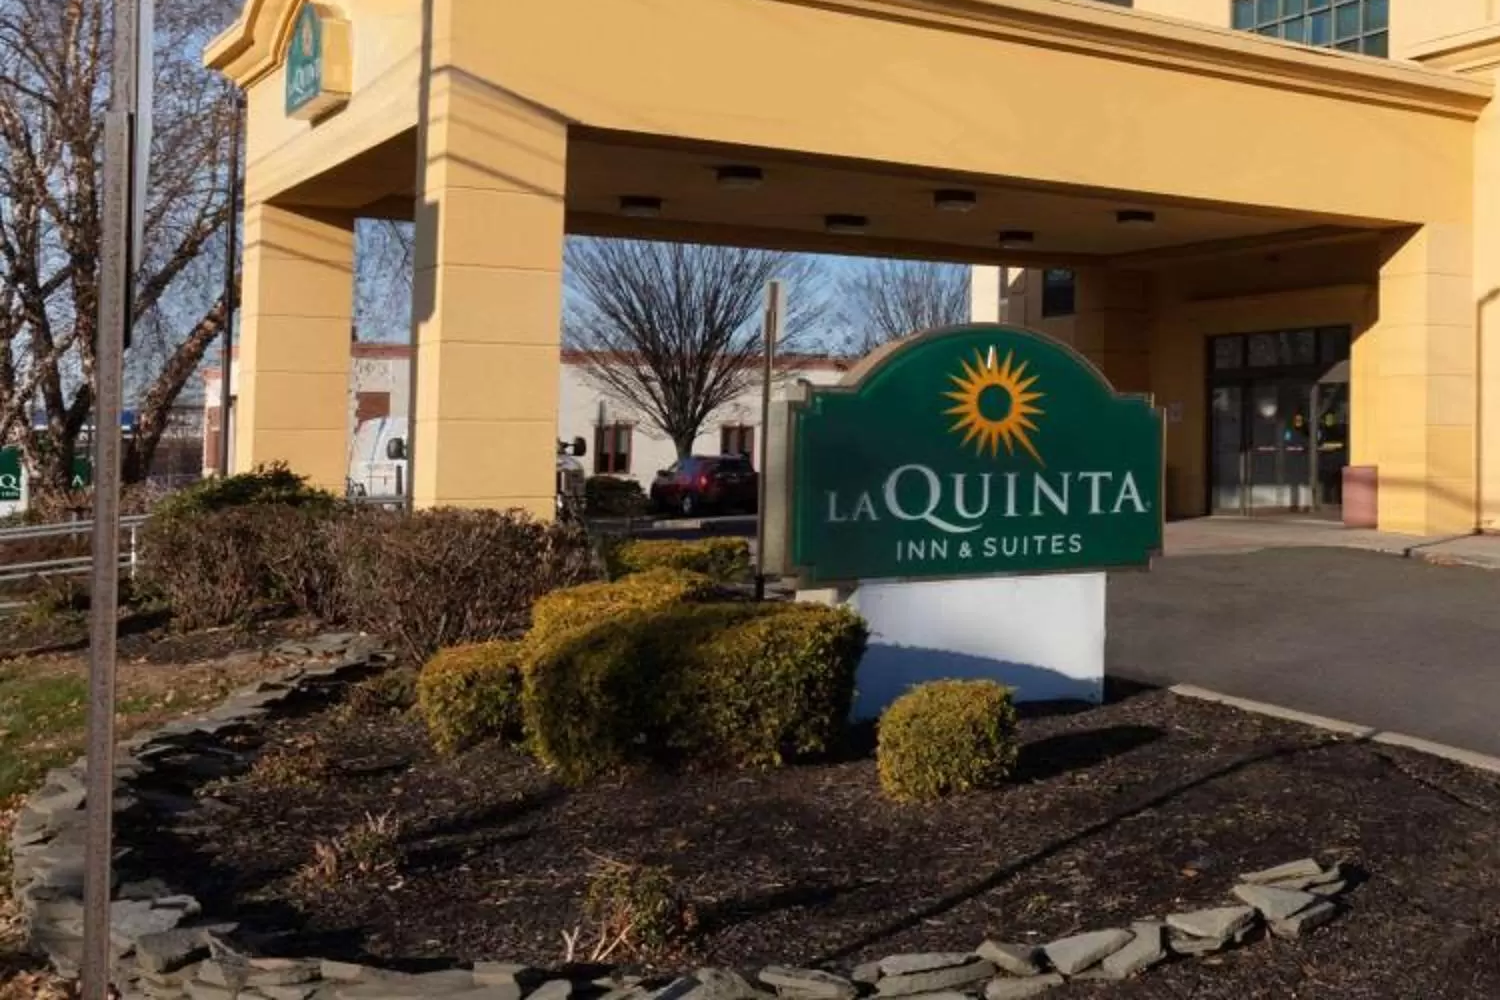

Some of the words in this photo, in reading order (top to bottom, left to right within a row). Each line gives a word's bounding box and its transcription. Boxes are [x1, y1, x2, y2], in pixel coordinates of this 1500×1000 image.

[824, 490, 881, 523] LA
[882, 463, 1149, 534] QUINTA
[896, 537, 948, 561] INN
[959, 540, 973, 558] &
[983, 533, 1083, 558] SUITES
